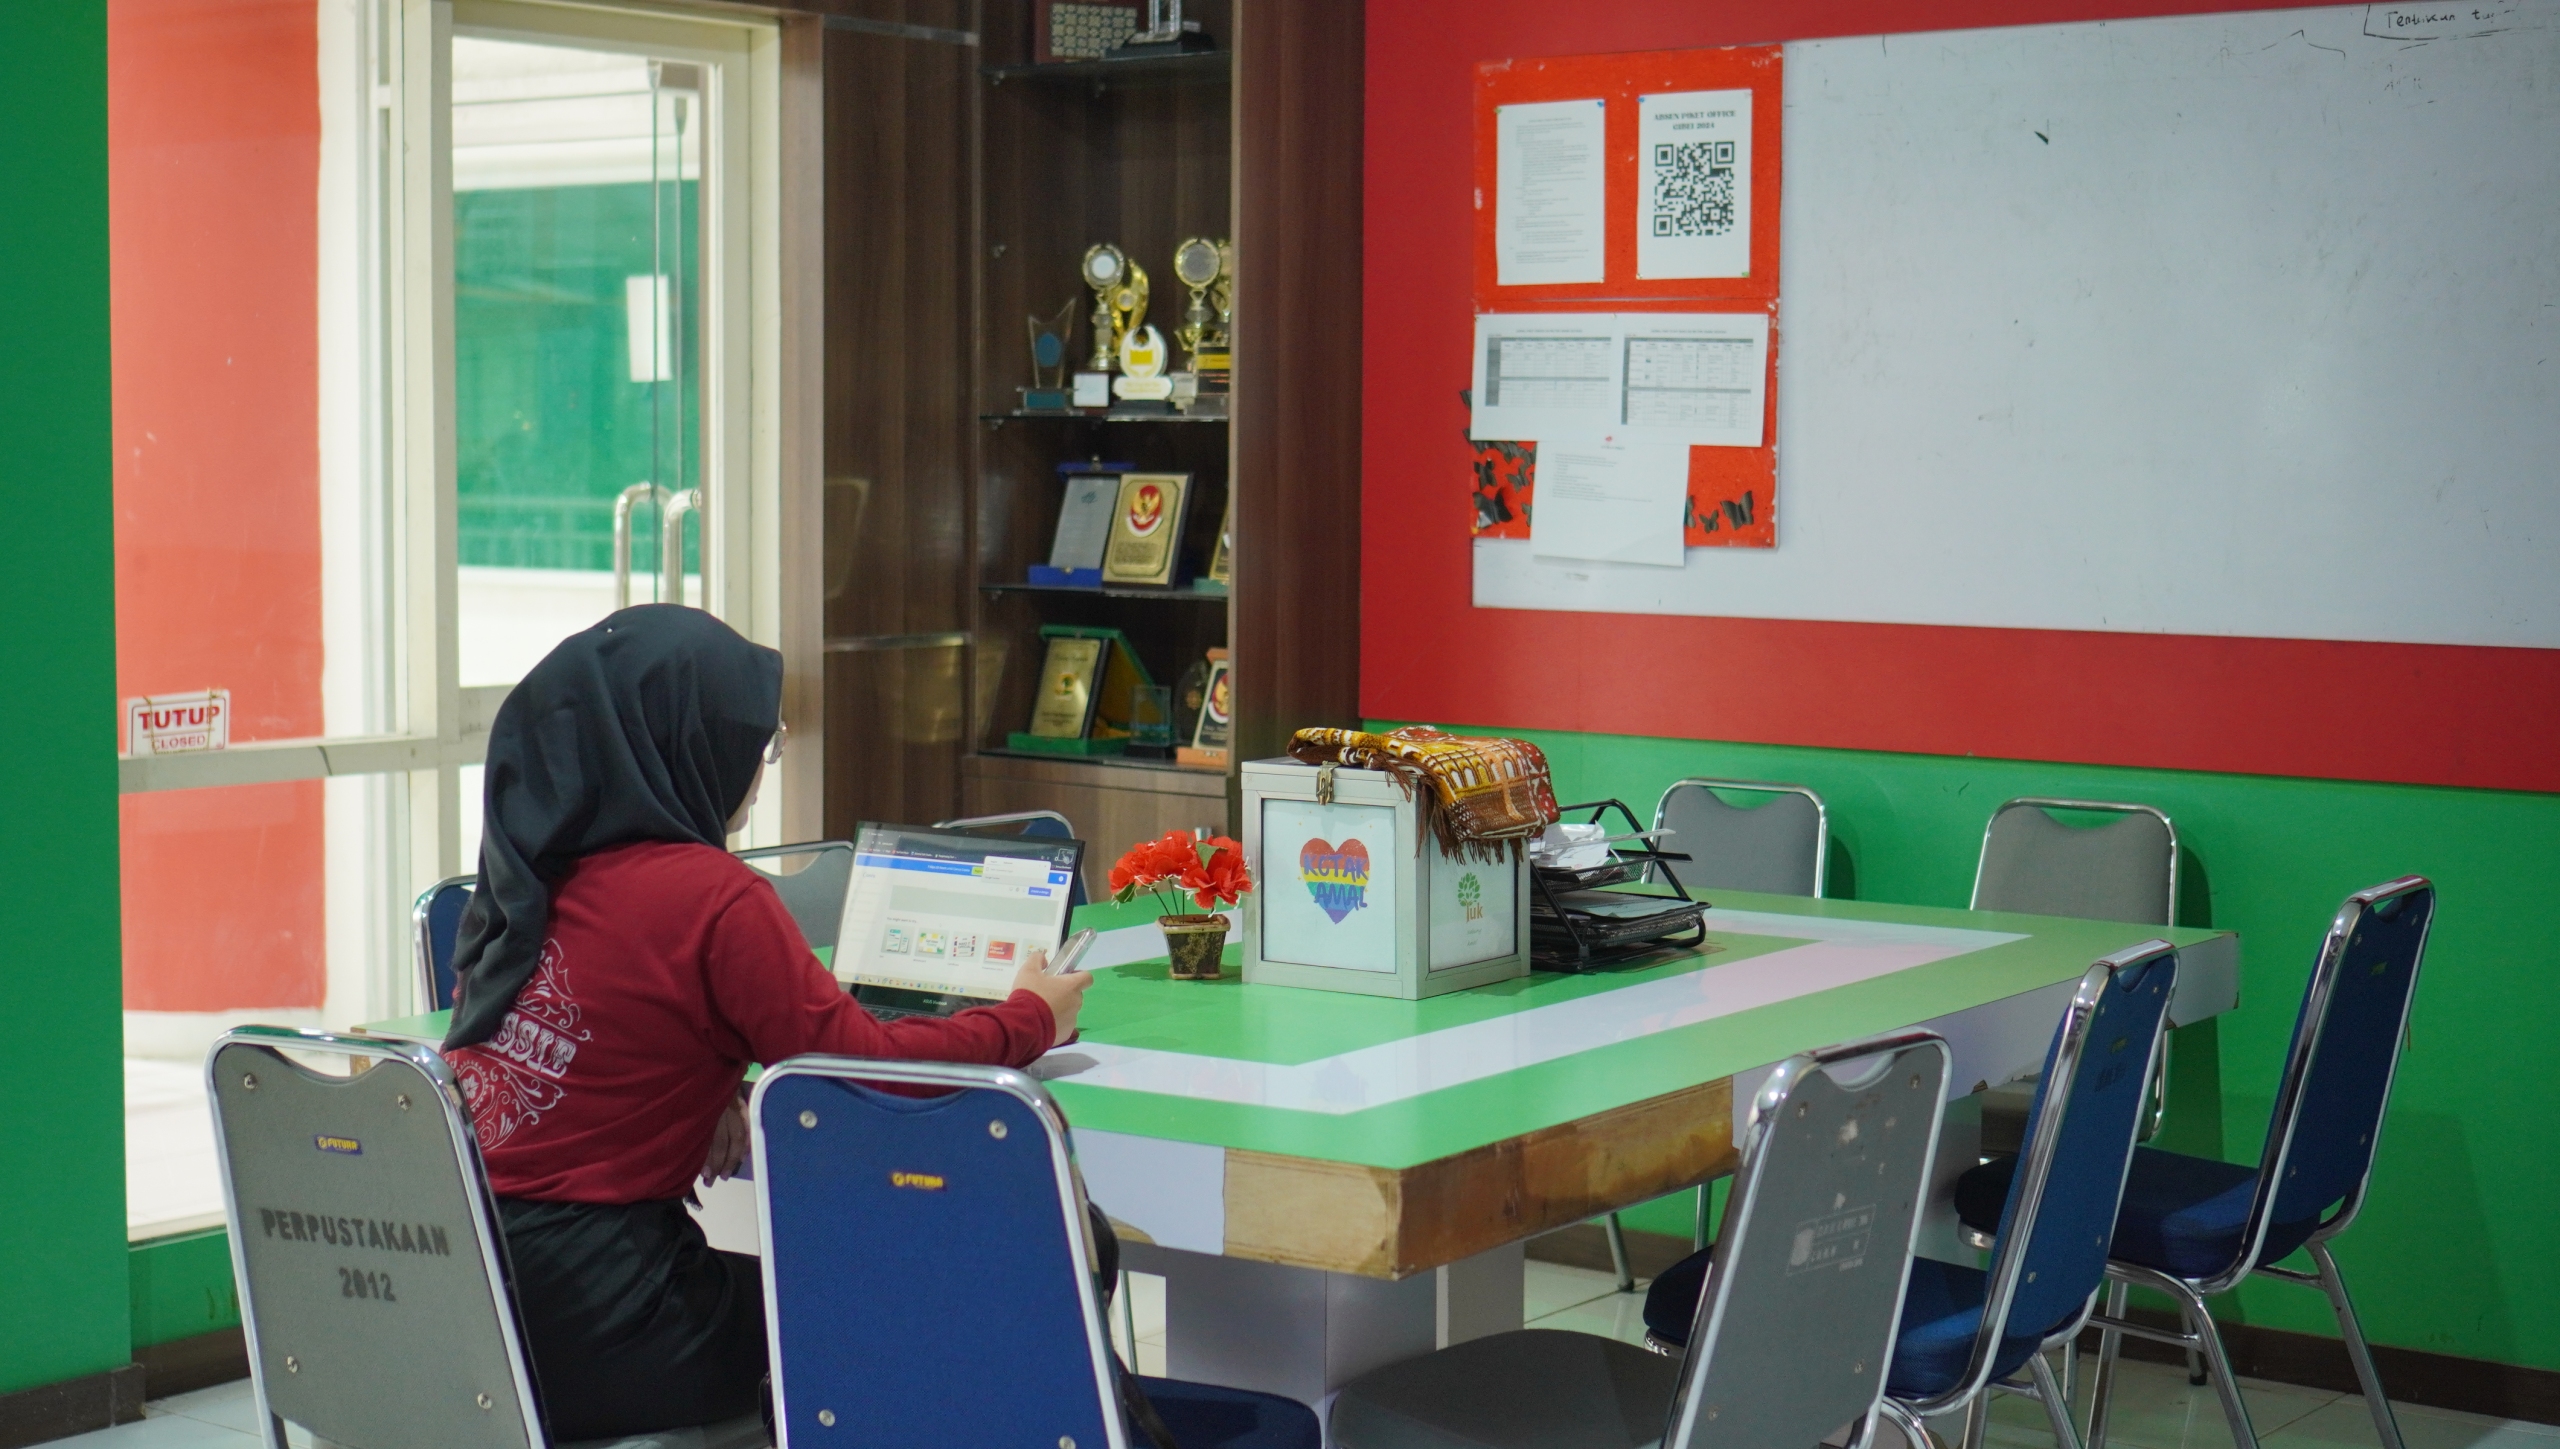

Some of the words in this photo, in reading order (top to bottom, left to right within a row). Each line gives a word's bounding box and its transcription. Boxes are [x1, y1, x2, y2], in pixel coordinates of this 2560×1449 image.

[138, 706, 220, 730] TUTUP
[155, 734, 206, 750] CLOSED
[1303, 854, 1369, 882] KOTAK
[1314, 882, 1368, 911] AMAL
[483, 1012, 577, 1079] SSIE
[260, 1208, 450, 1256] PERPUSTAKAAN
[339, 1266, 397, 1302] 2012
